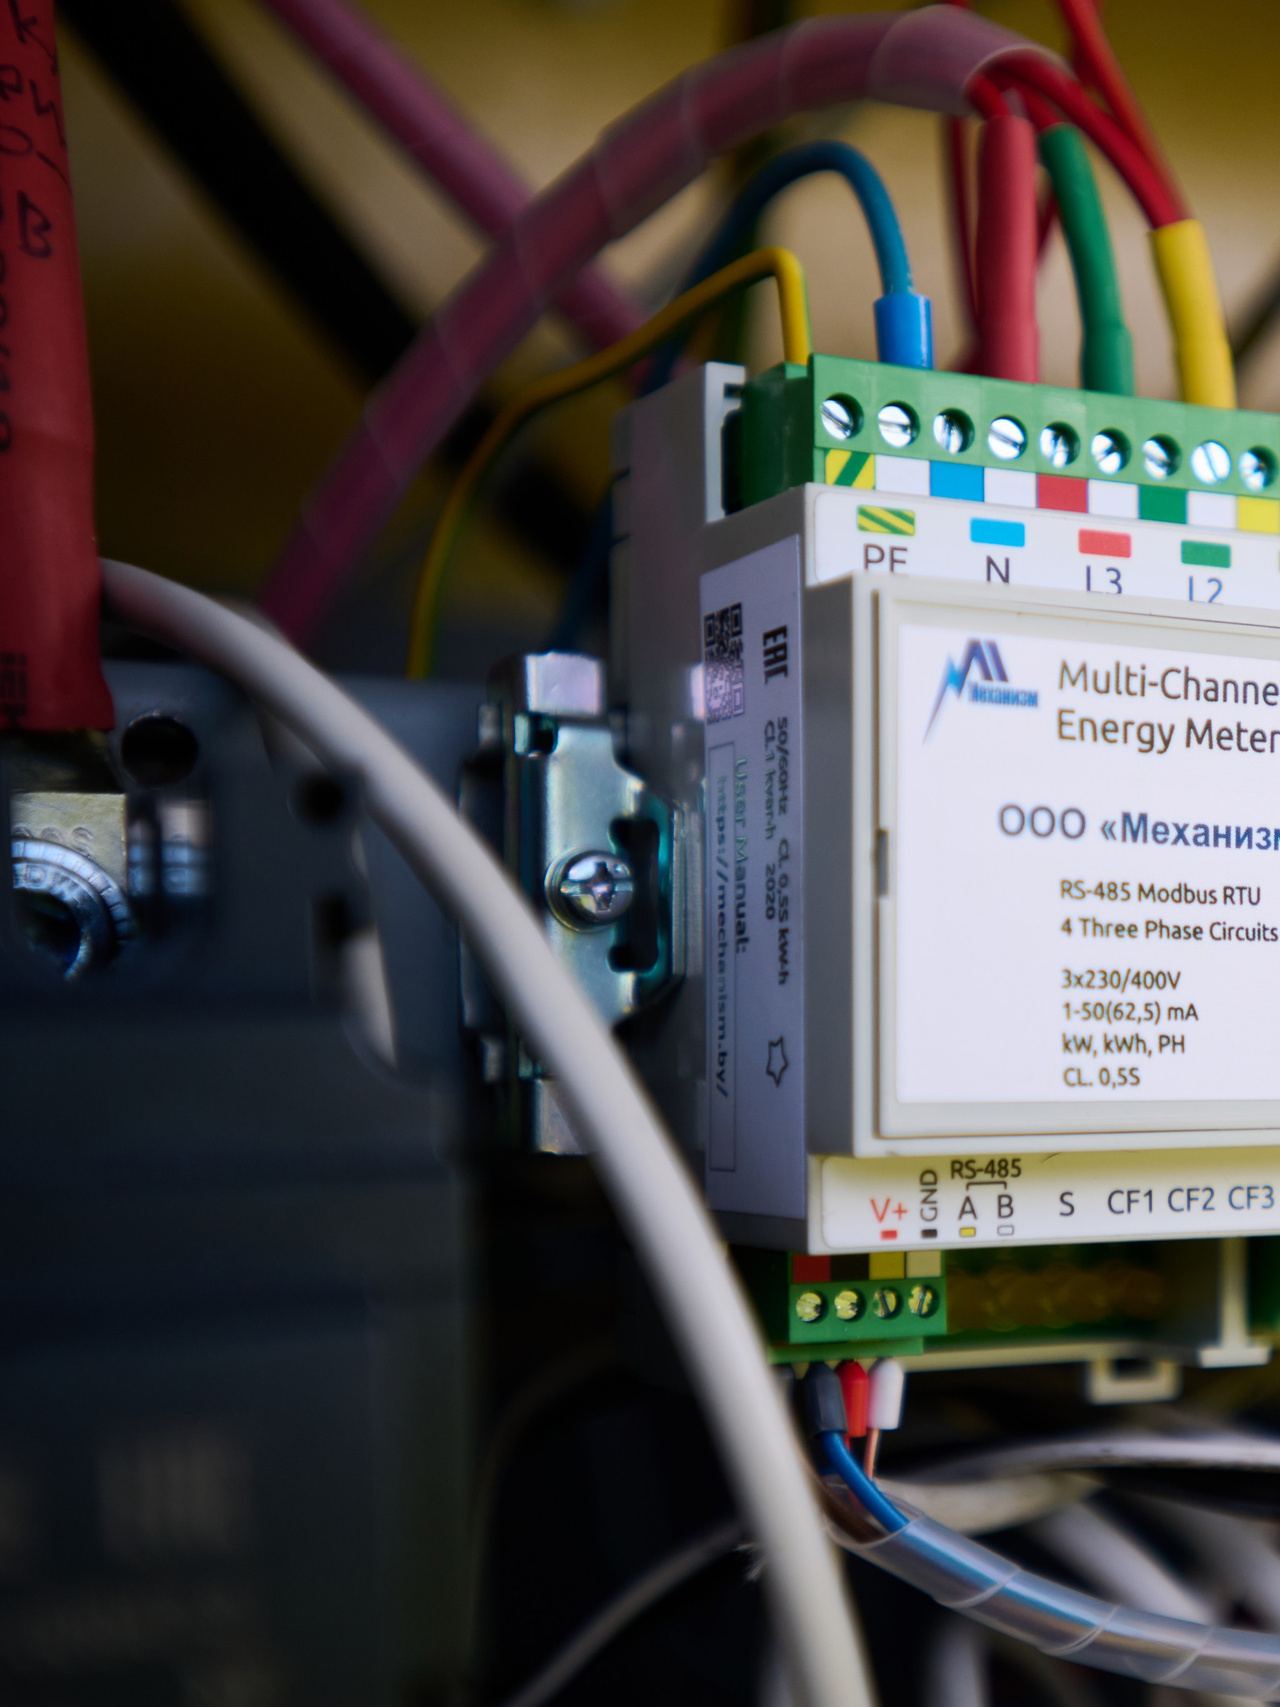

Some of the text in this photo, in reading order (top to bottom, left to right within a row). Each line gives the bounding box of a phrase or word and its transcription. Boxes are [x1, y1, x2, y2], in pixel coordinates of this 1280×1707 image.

[986, 555, 1010, 584] N
[1086, 565, 1122, 594] L3
[1188, 576, 1223, 604] L2
[1057, 708, 1175, 755] Energy
[735, 757, 750, 955] User Manual:
[765, 863, 776, 920] 2020
[1060, 879, 1262, 906] RS-485 Modbus RTU
[1061, 917, 1279, 943] 4 Three Phase Circuits
[1061, 967, 1181, 993] 3x230/400V
[1063, 1000, 1199, 1026] 1-50(62,5) mA
[1062, 1033, 1185, 1057] kW, kWh, PH
[1064, 1067, 1141, 1089] CL. 0,5S
[951, 1158, 1022, 1180] RS-485
[870, 1197, 908, 1223] V+
[919, 1169, 938, 1222] GND
[958, 1195, 978, 1220] A
[997, 1194, 1014, 1219] B
[1059, 1191, 1075, 1217] S
[1107, 1189, 1153, 1214] CF1
[1168, 1187, 1216, 1212] CF2
[1228, 1185, 1275, 1210] CF3
